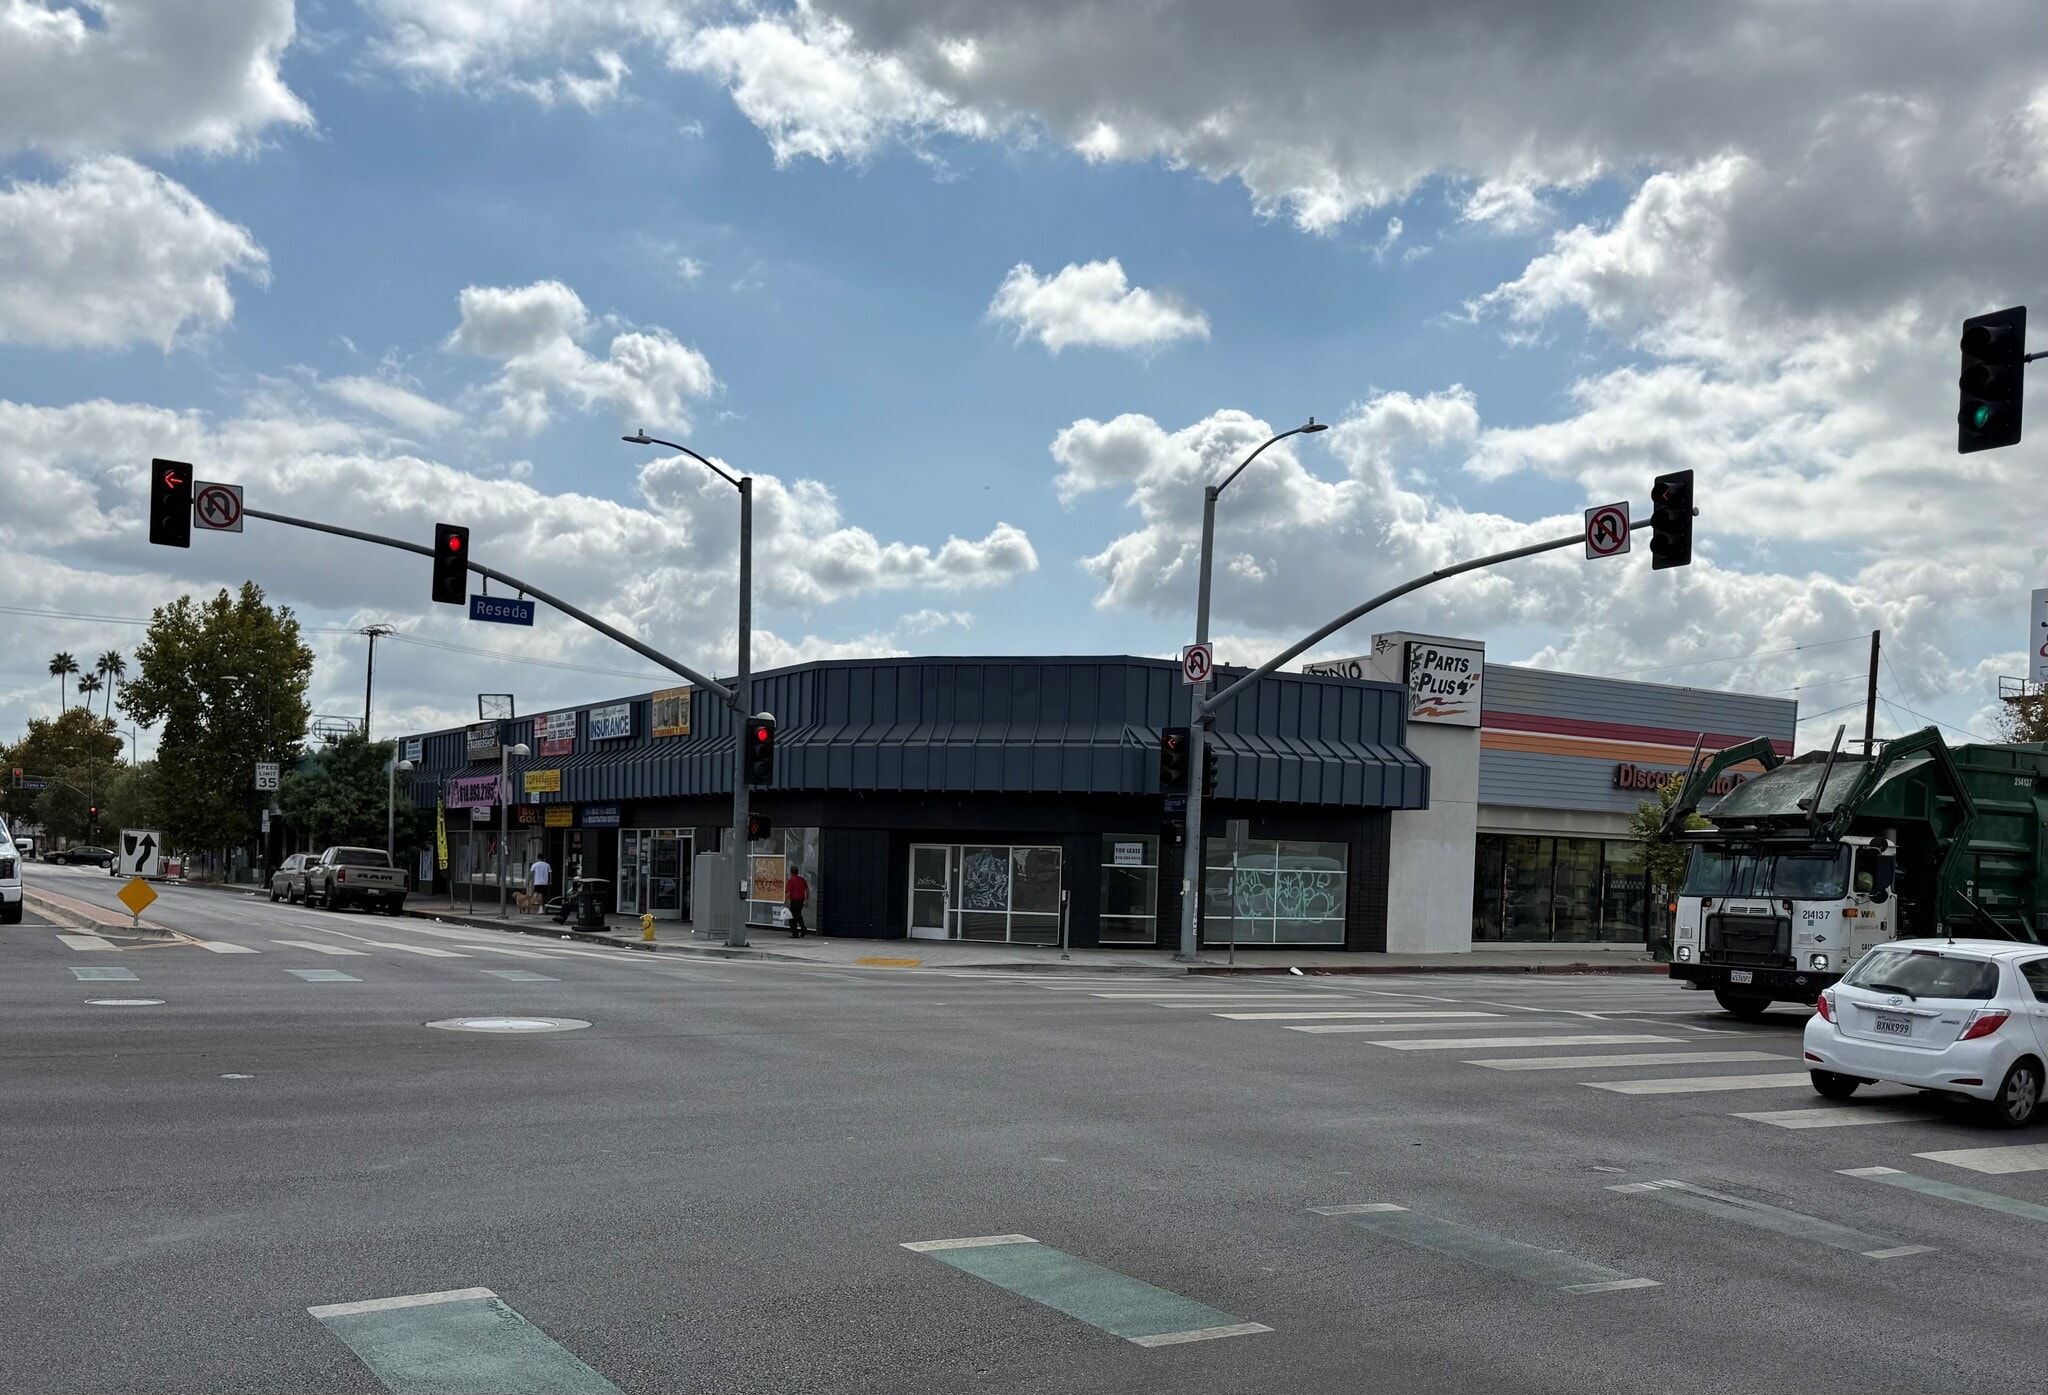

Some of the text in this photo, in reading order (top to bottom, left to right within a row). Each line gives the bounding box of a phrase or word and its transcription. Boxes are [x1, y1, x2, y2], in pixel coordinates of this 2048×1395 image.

[477, 601, 528, 619] Reseda
[1423, 650, 1470, 673] PARTS
[590, 715, 629, 739] INSURANCE
[258, 777, 277, 788] 35
[2014, 777, 2033, 787] 214137
[521, 808, 542, 816] BUY
[519, 815, 545, 824] GOLD
[357, 873, 393, 881] RAM
[1803, 910, 1831, 920] 214137
[1861, 910, 1876, 918] WM
